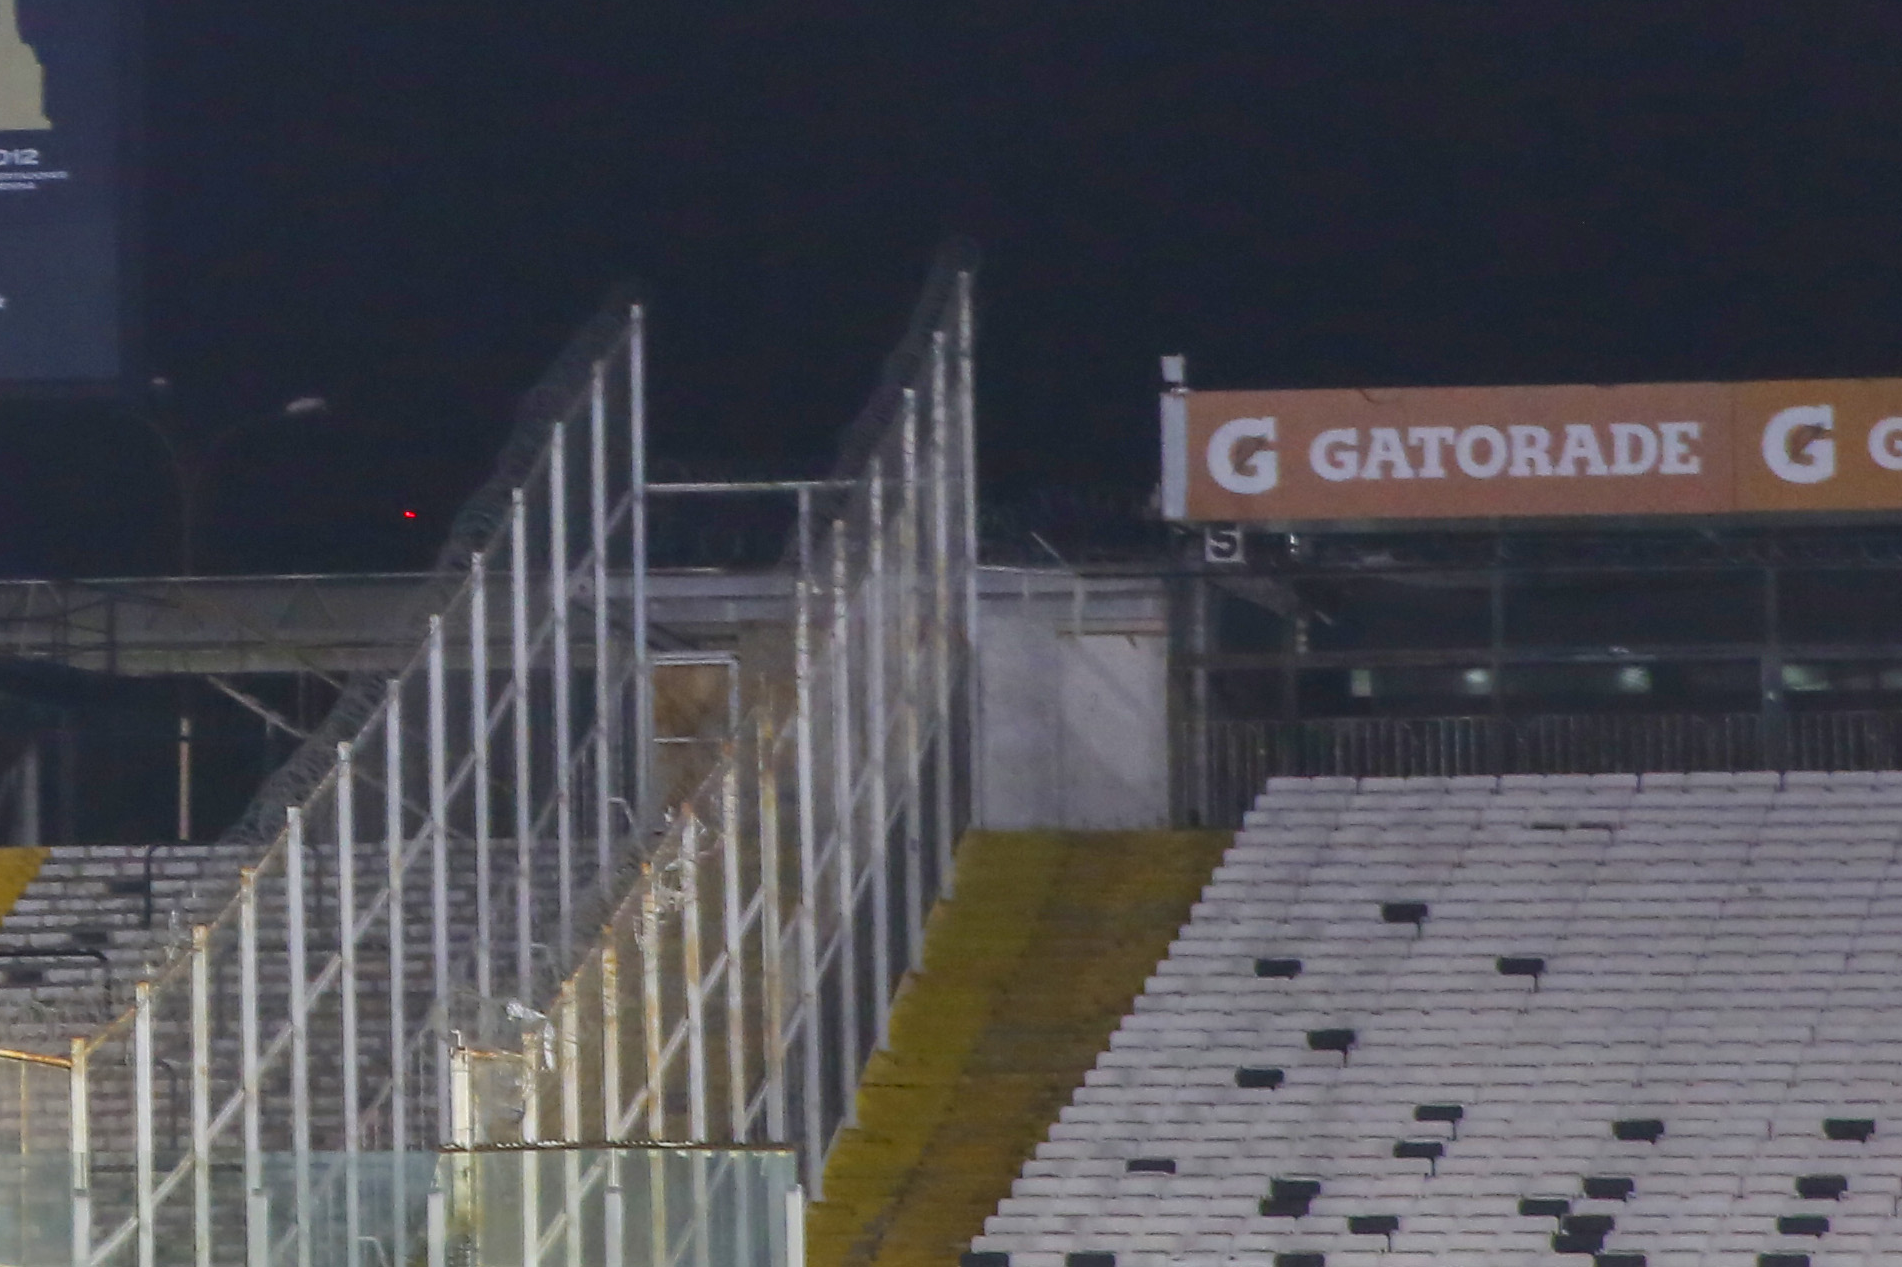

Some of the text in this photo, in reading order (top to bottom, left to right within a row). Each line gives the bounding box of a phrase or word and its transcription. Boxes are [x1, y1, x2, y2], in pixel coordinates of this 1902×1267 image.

[1206, 416, 1703, 494] G GATORADE
[1762, 404, 1836, 484] G
